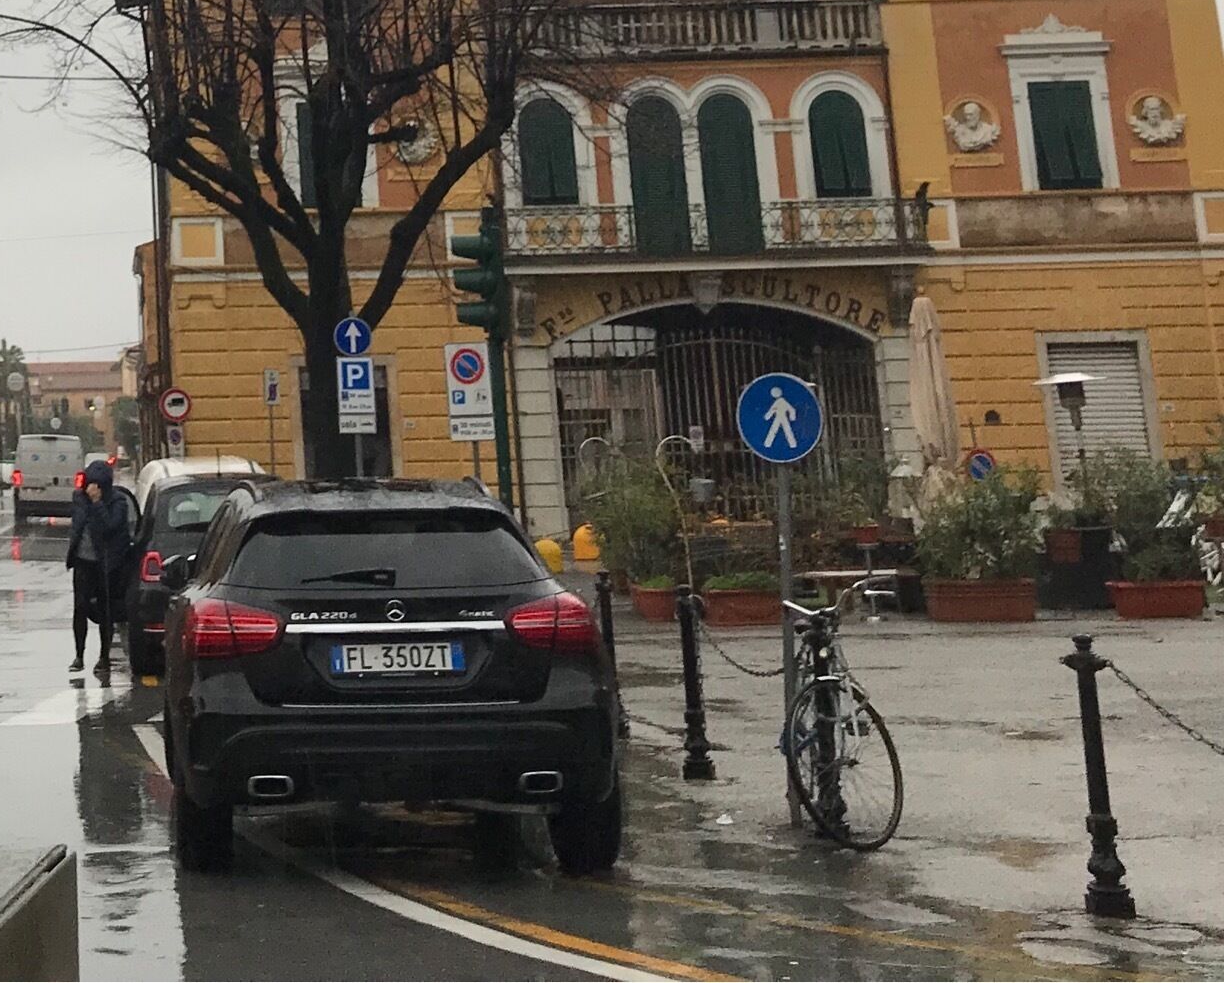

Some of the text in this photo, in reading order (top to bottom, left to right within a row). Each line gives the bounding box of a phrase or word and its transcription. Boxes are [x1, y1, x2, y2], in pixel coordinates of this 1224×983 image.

[597, 272, 694, 316] PALLA
[720, 271, 887, 333] SCULTORE
[346, 364, 364, 388] P
[454, 392, 464, 404] P
[290, 612, 319, 621] GLA
[345, 646, 373, 671] FL
[382, 644, 449, 670] 350ZT
